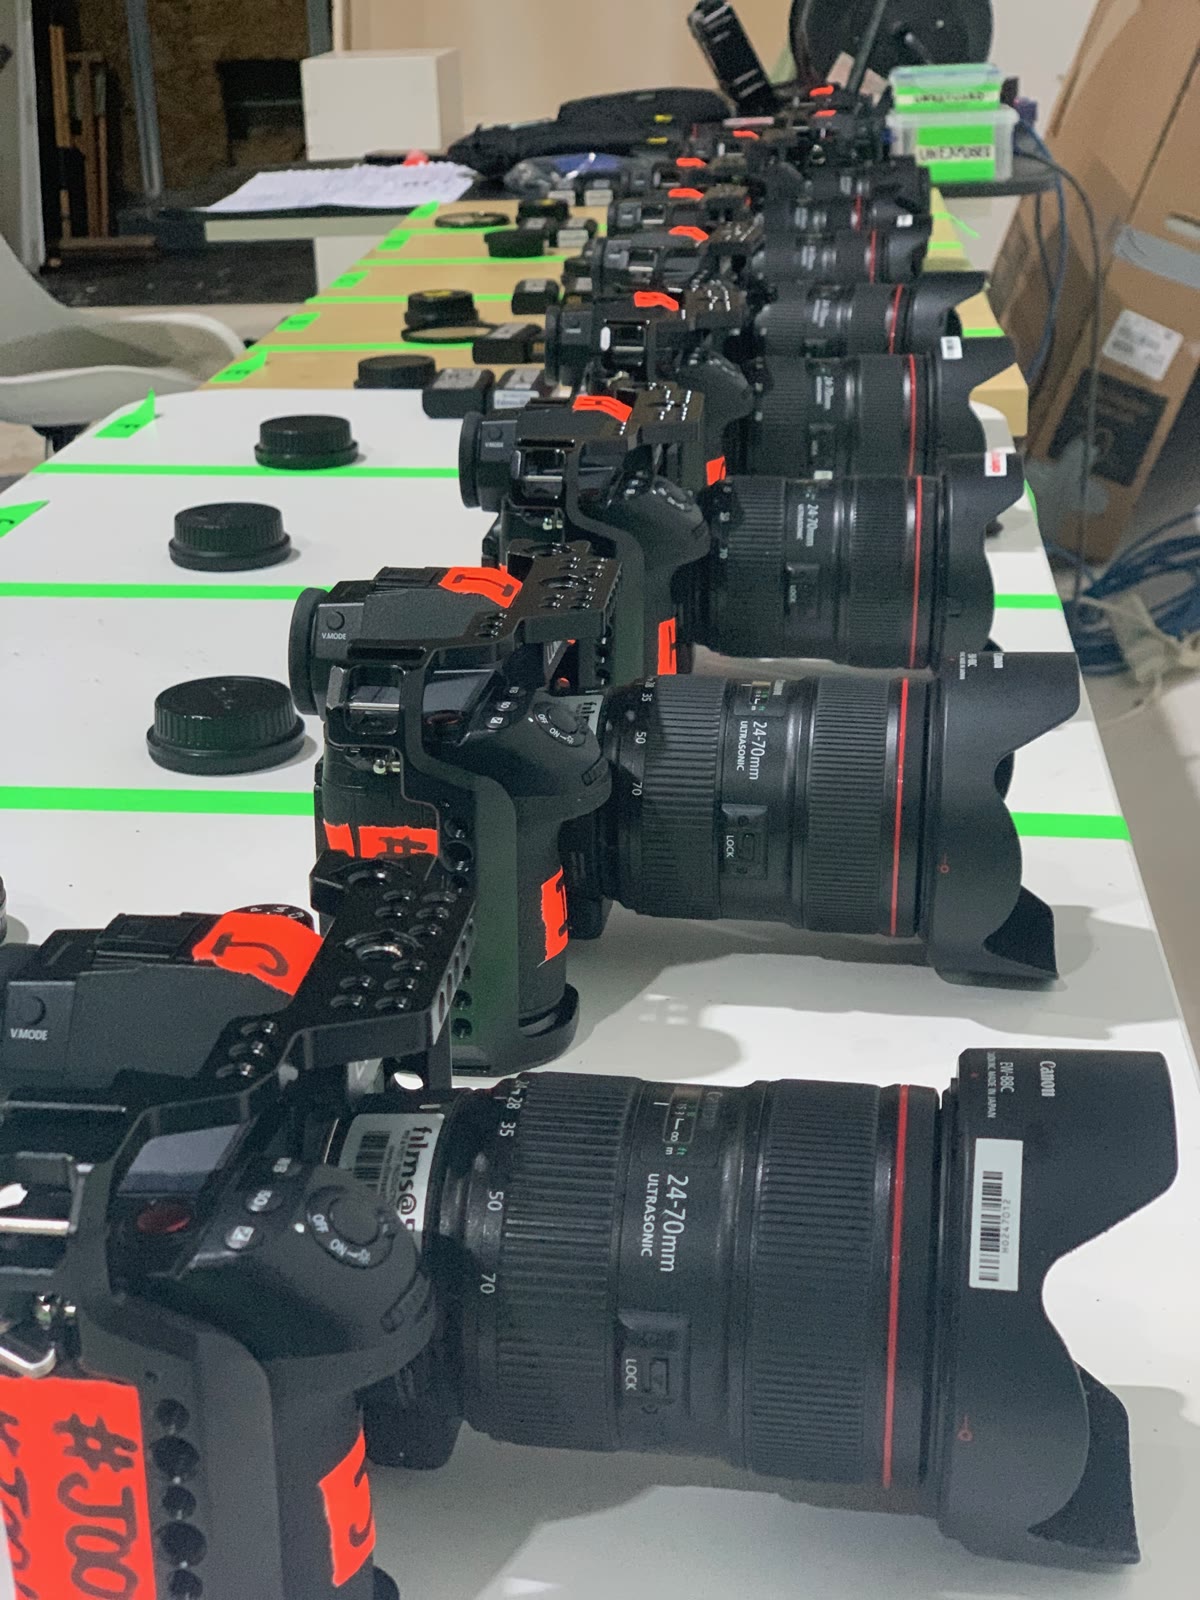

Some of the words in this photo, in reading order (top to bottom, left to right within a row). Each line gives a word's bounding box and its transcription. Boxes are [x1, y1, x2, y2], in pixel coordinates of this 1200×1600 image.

[805, 503, 820, 547] 24-70mm
[537, 713, 549, 725] OFF
[549, 727, 561, 738] ON
[635, 731, 647, 744] 50
[736, 720, 748, 772] ULTRASONIC
[748, 720, 768, 781] 24-70mm
[631, 782, 643, 796] 70
[725, 833, 735, 859] LOCK
[999, 1061, 1015, 1093] EW-88C
[1039, 1060, 1057, 1097] Canon
[505, 1096, 523, 1109] 28
[987, 1096, 997, 1119] JAPAN
[499, 1121, 517, 1137] 35
[487, 1191, 504, 1211] 50
[640, 1172, 660, 1258] ULTRASONIC
[659, 1173, 689, 1273] 24-70mm
[330, 1238, 348, 1257] ON
[480, 1273, 496, 1294] 70
[624, 1358, 637, 1391] LOCK
